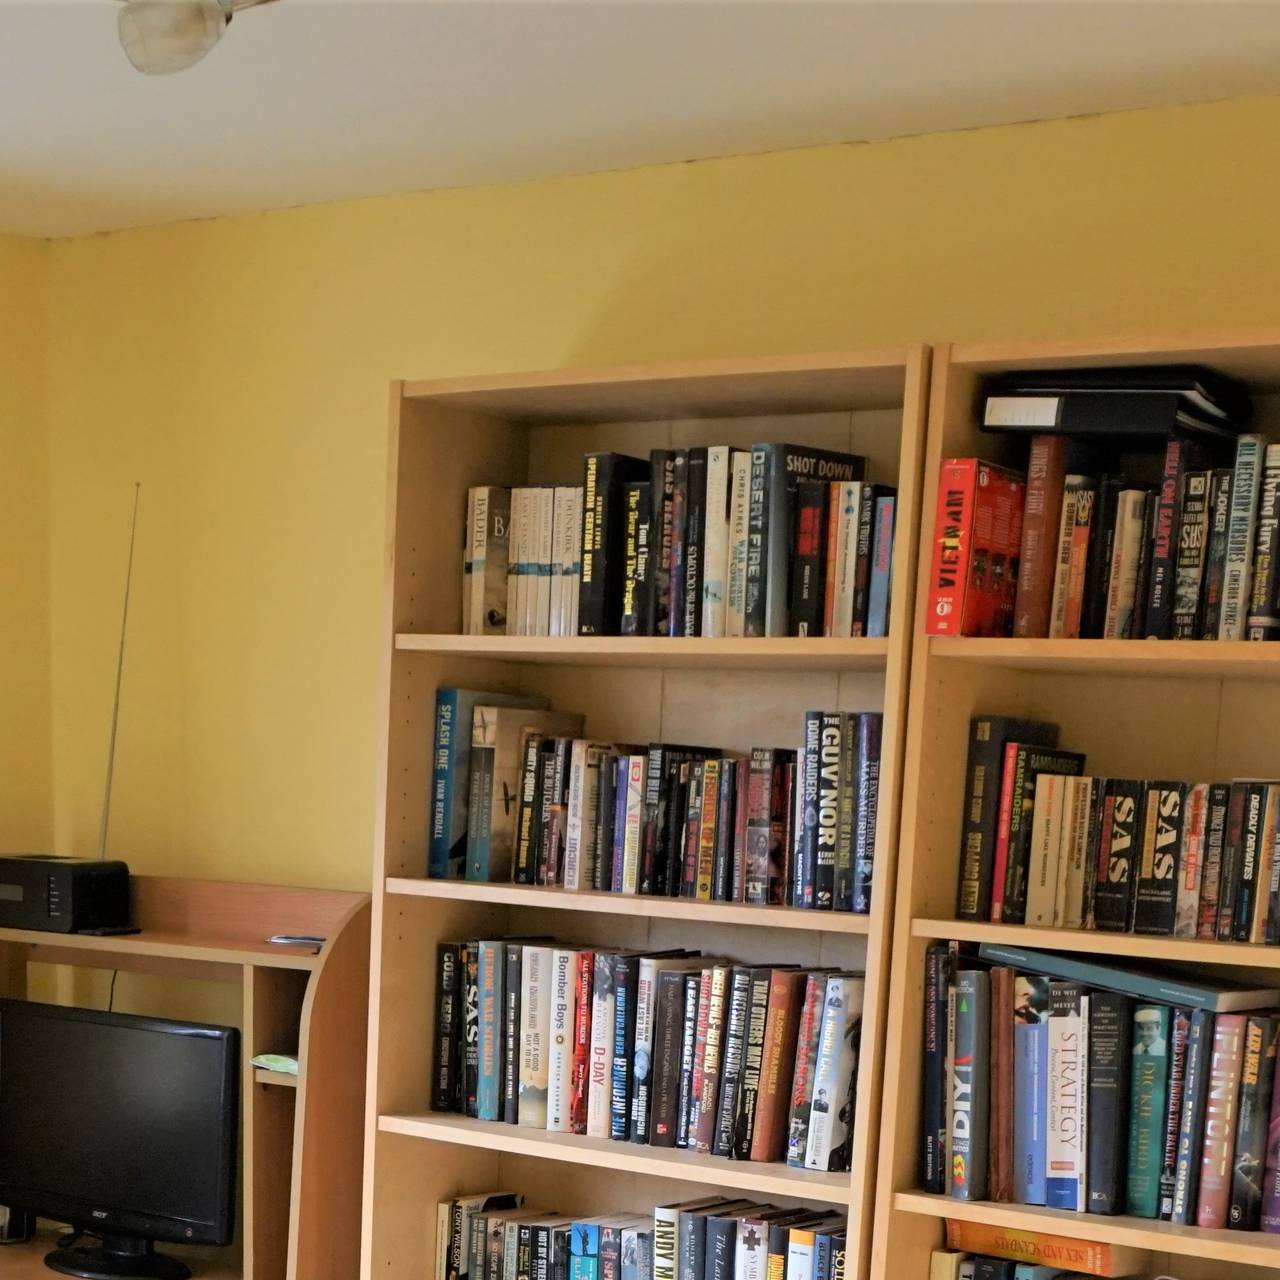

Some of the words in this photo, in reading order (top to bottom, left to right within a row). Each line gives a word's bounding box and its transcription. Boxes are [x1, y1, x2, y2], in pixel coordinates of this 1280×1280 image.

[586, 458, 597, 508] OPERATION
[786, 454, 816, 475] SHOT
[818, 460, 854, 480] DOWN
[629, 489, 639, 508] The
[750, 452, 765, 529] DESERT
[473, 498, 487, 550] BADER
[626, 510, 638, 536] Bear
[860, 500, 872, 524] DARK
[584, 511, 595, 550] CERTAIN
[626, 539, 637, 556] and
[638, 523, 650, 542] Tom
[857, 526, 870, 555] TRUTHS
[938, 490, 964, 588] VIETNAM
[582, 553, 593, 582] DEATH
[625, 559, 636, 577] The
[634, 545, 649, 581] Clancy
[747, 534, 761, 577] FIRE
[622, 579, 635, 616] Dragon
[439, 705, 452, 745] SPLASH
[807, 720, 820, 750] DOME
[437, 749, 449, 770] ONE
[805, 754, 818, 801] RAIDERS
[859, 760, 870, 795] MASS
[436, 780, 446, 799] IVAN
[818, 727, 841, 846] GUV'NOR
[1011, 751, 1027, 832] RAMRAIDERS
[434, 801, 445, 840] RENDALL
[856, 799, 868, 857] MURDER
[1248, 794, 1260, 832] DEADLY
[1108, 796, 1135, 883] SAS
[1153, 789, 1180, 880] SAS
[1243, 834, 1258, 880] DEVIATES
[557, 956, 568, 1000] Bomber
[753, 980, 768, 1004] THAT
[466, 985, 478, 1043] SAS
[555, 1003, 567, 1029] Boys
[685, 989, 697, 1019] EASY
[750, 1006, 766, 1044] OTHERS
[683, 1021, 695, 1071] TARGET
[746, 1046, 761, 1067] MAY
[592, 1047, 606, 1086] D-DAY
[744, 1069, 758, 1090] LIVE
[1059, 1032, 1078, 1149] STRATEGY
[454, 1208, 462, 1231] TONY
[453, 1233, 461, 1267] WILSON
[537, 1247, 547, 1257] BY
[538, 1231, 547, 1246] NOT
[655, 1219, 674, 1260] ANDY
[715, 1235, 726, 1255] The
